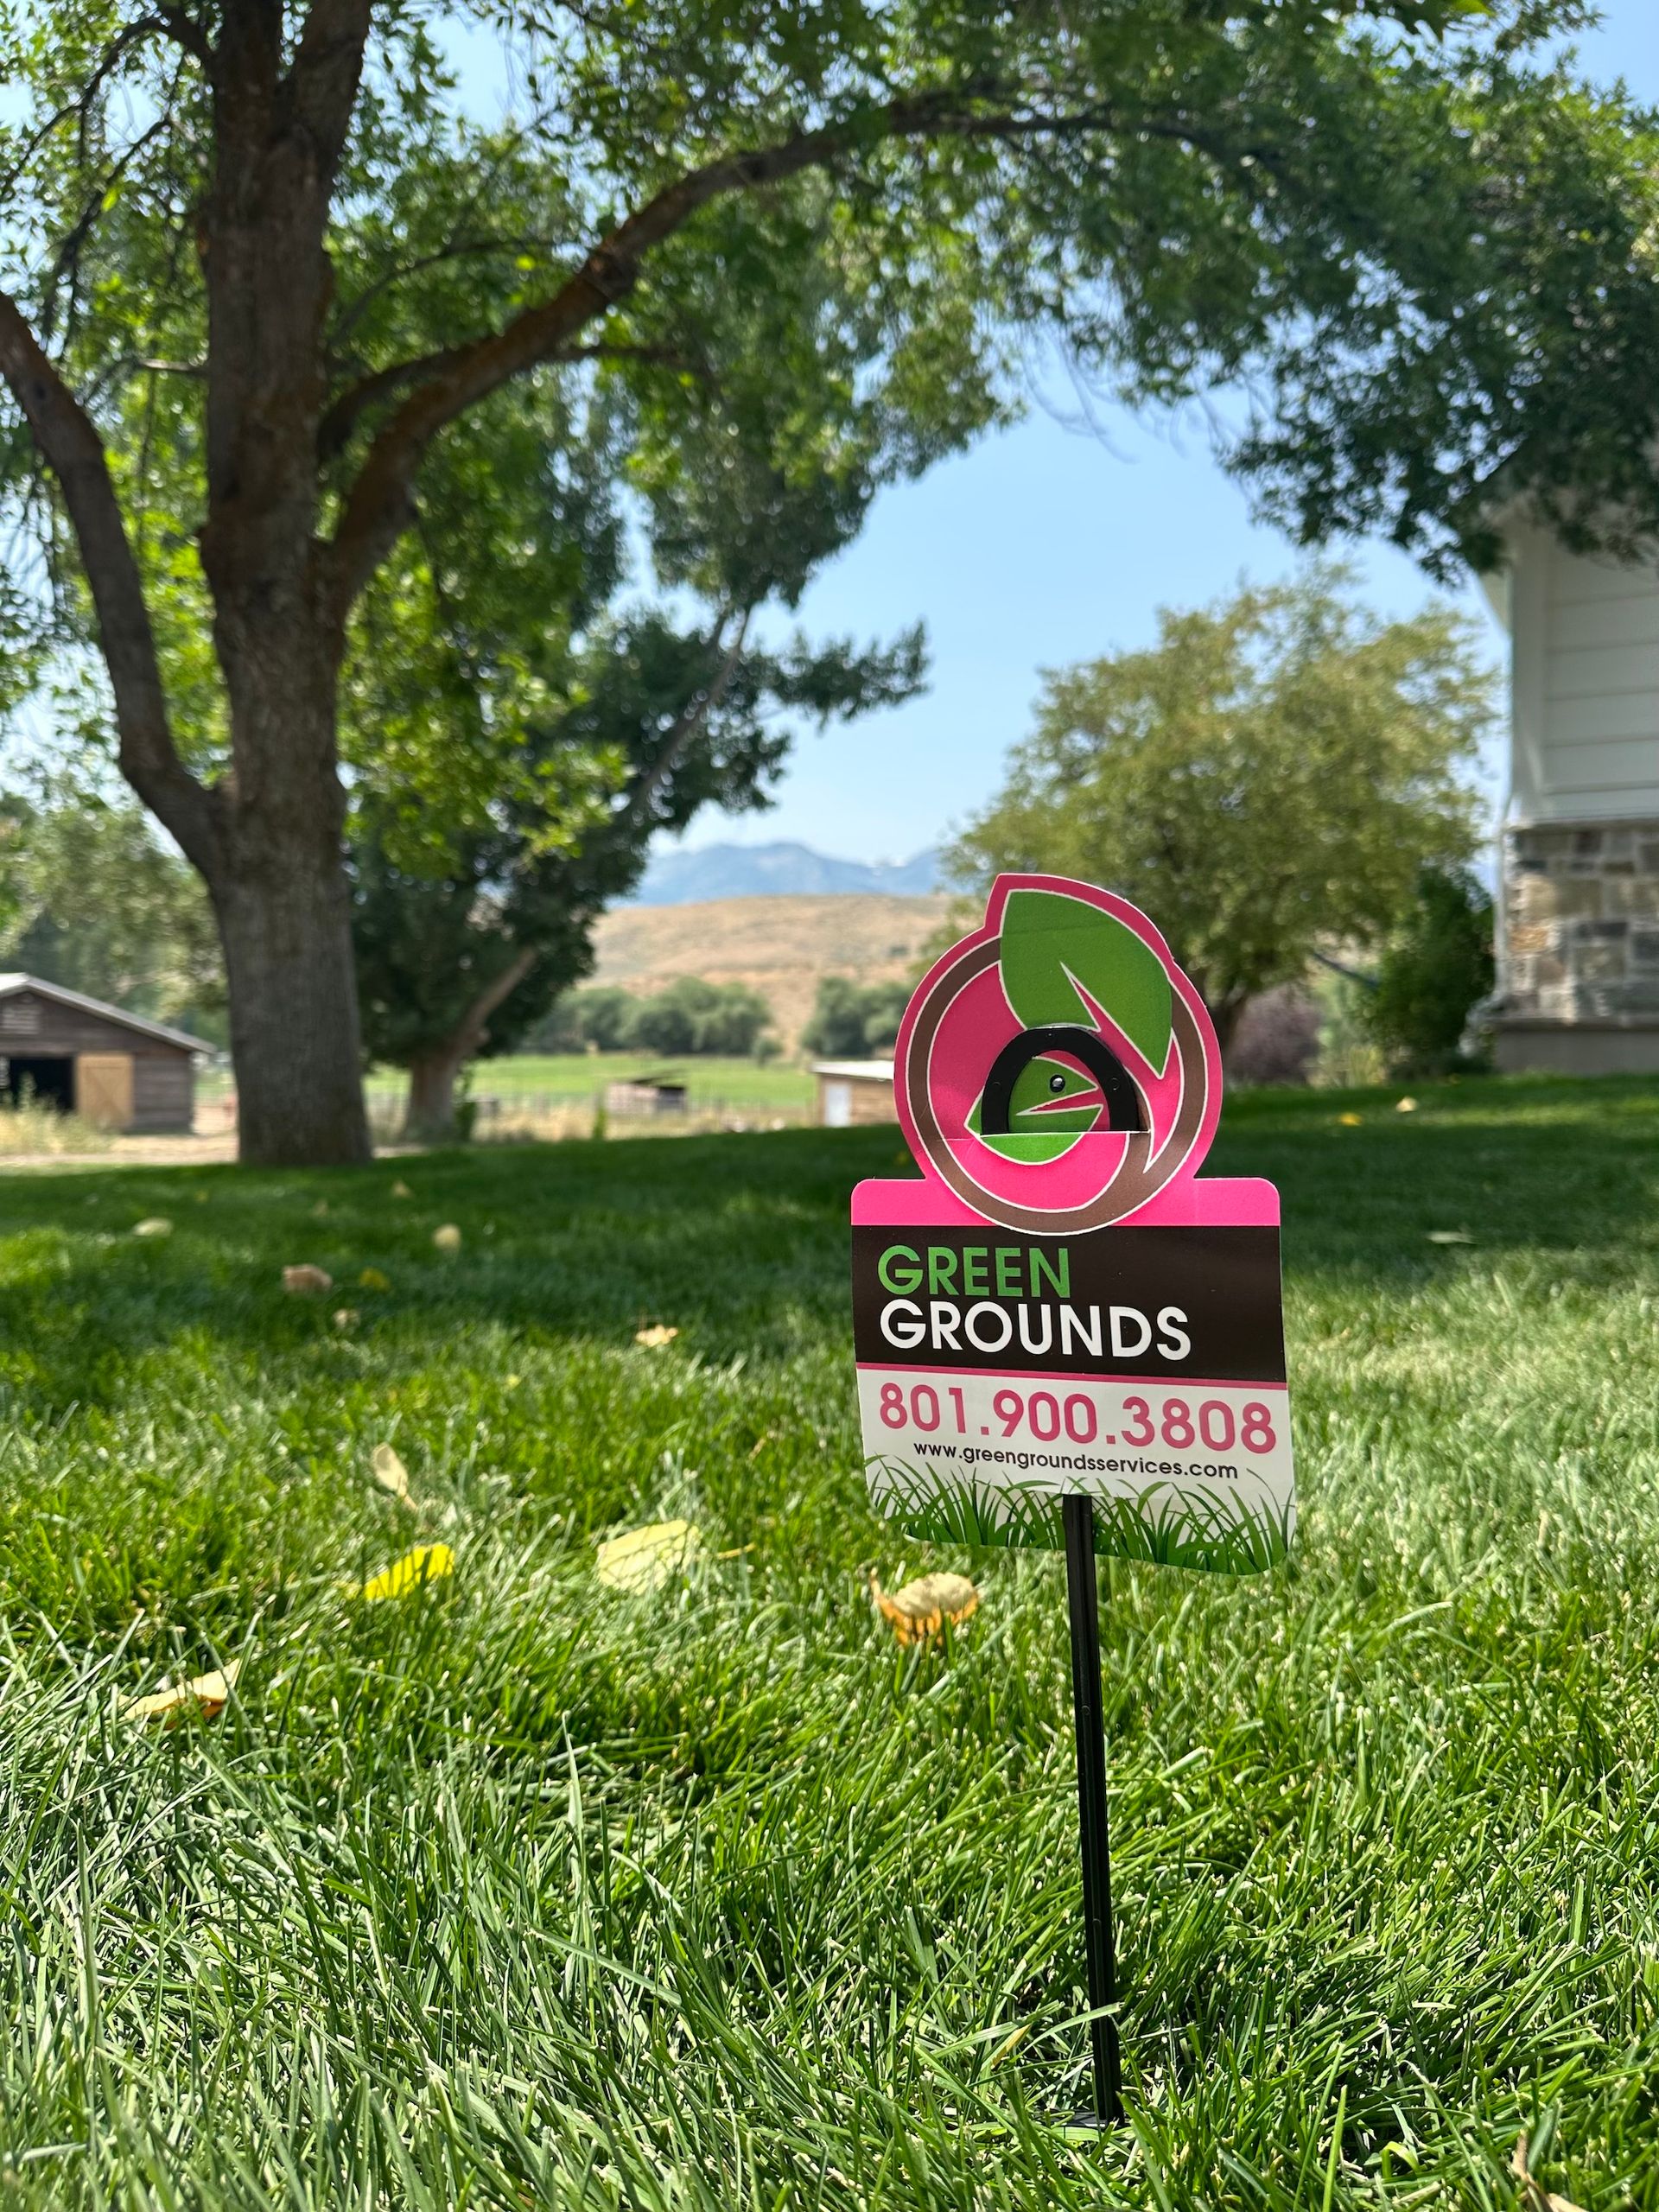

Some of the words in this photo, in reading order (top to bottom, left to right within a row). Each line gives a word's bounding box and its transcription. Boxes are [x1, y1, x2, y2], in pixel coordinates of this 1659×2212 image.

[877, 1244, 1071, 1299] GREEN
[880, 1299, 1192, 1361] GROUNDS
[879, 1382, 1277, 1454] 801.900.3808
[913, 1441, 1238, 1480] www.greengroundsservices.com
